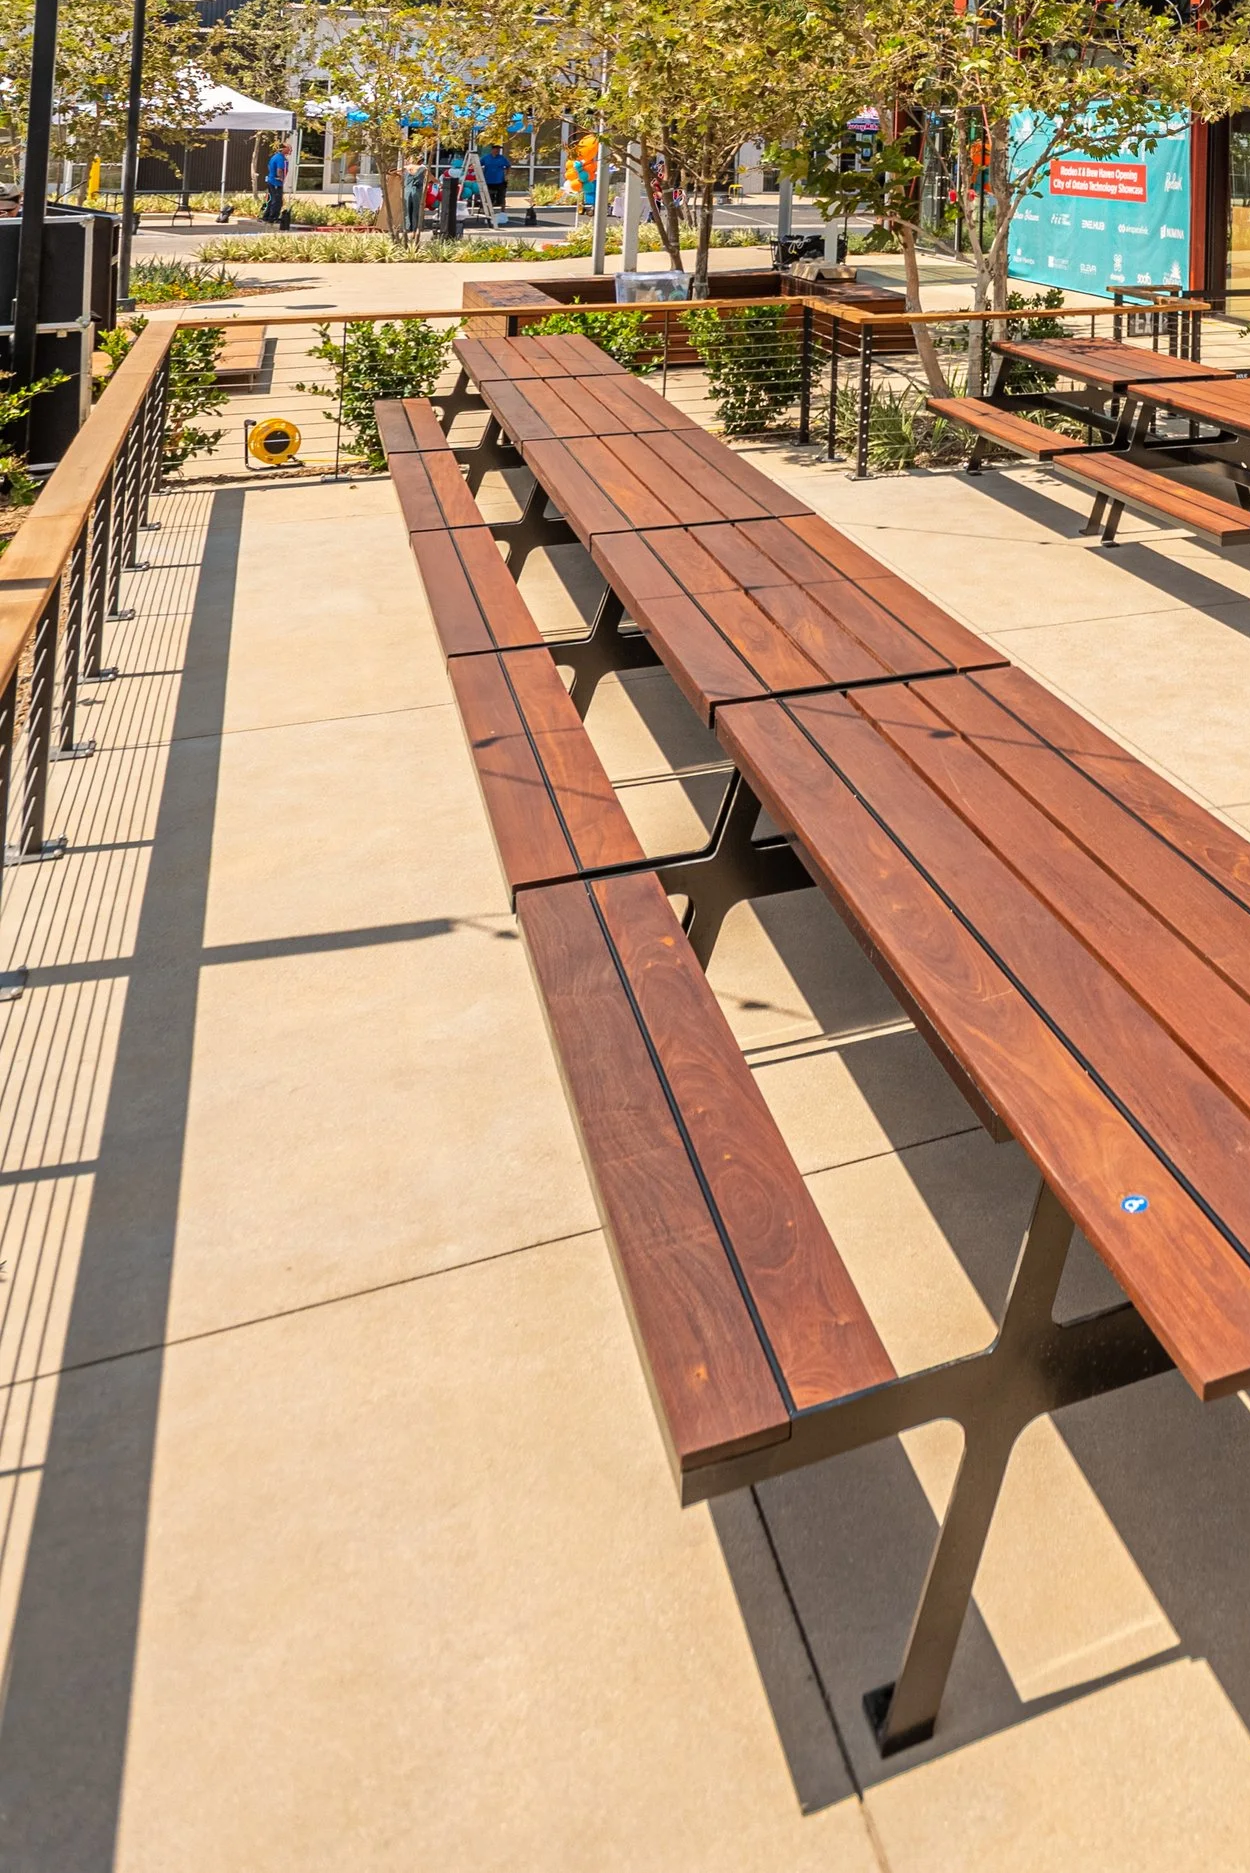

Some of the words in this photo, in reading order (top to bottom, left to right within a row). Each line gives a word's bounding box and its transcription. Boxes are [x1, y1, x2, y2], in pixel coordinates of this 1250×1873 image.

[1115, 169, 1138, 182] Opening
[1053, 178, 1065, 190] City
[1065, 179, 1072, 189] of
[1089, 181, 1118, 195] Technology
[1118, 183, 1144, 195] Showcase
